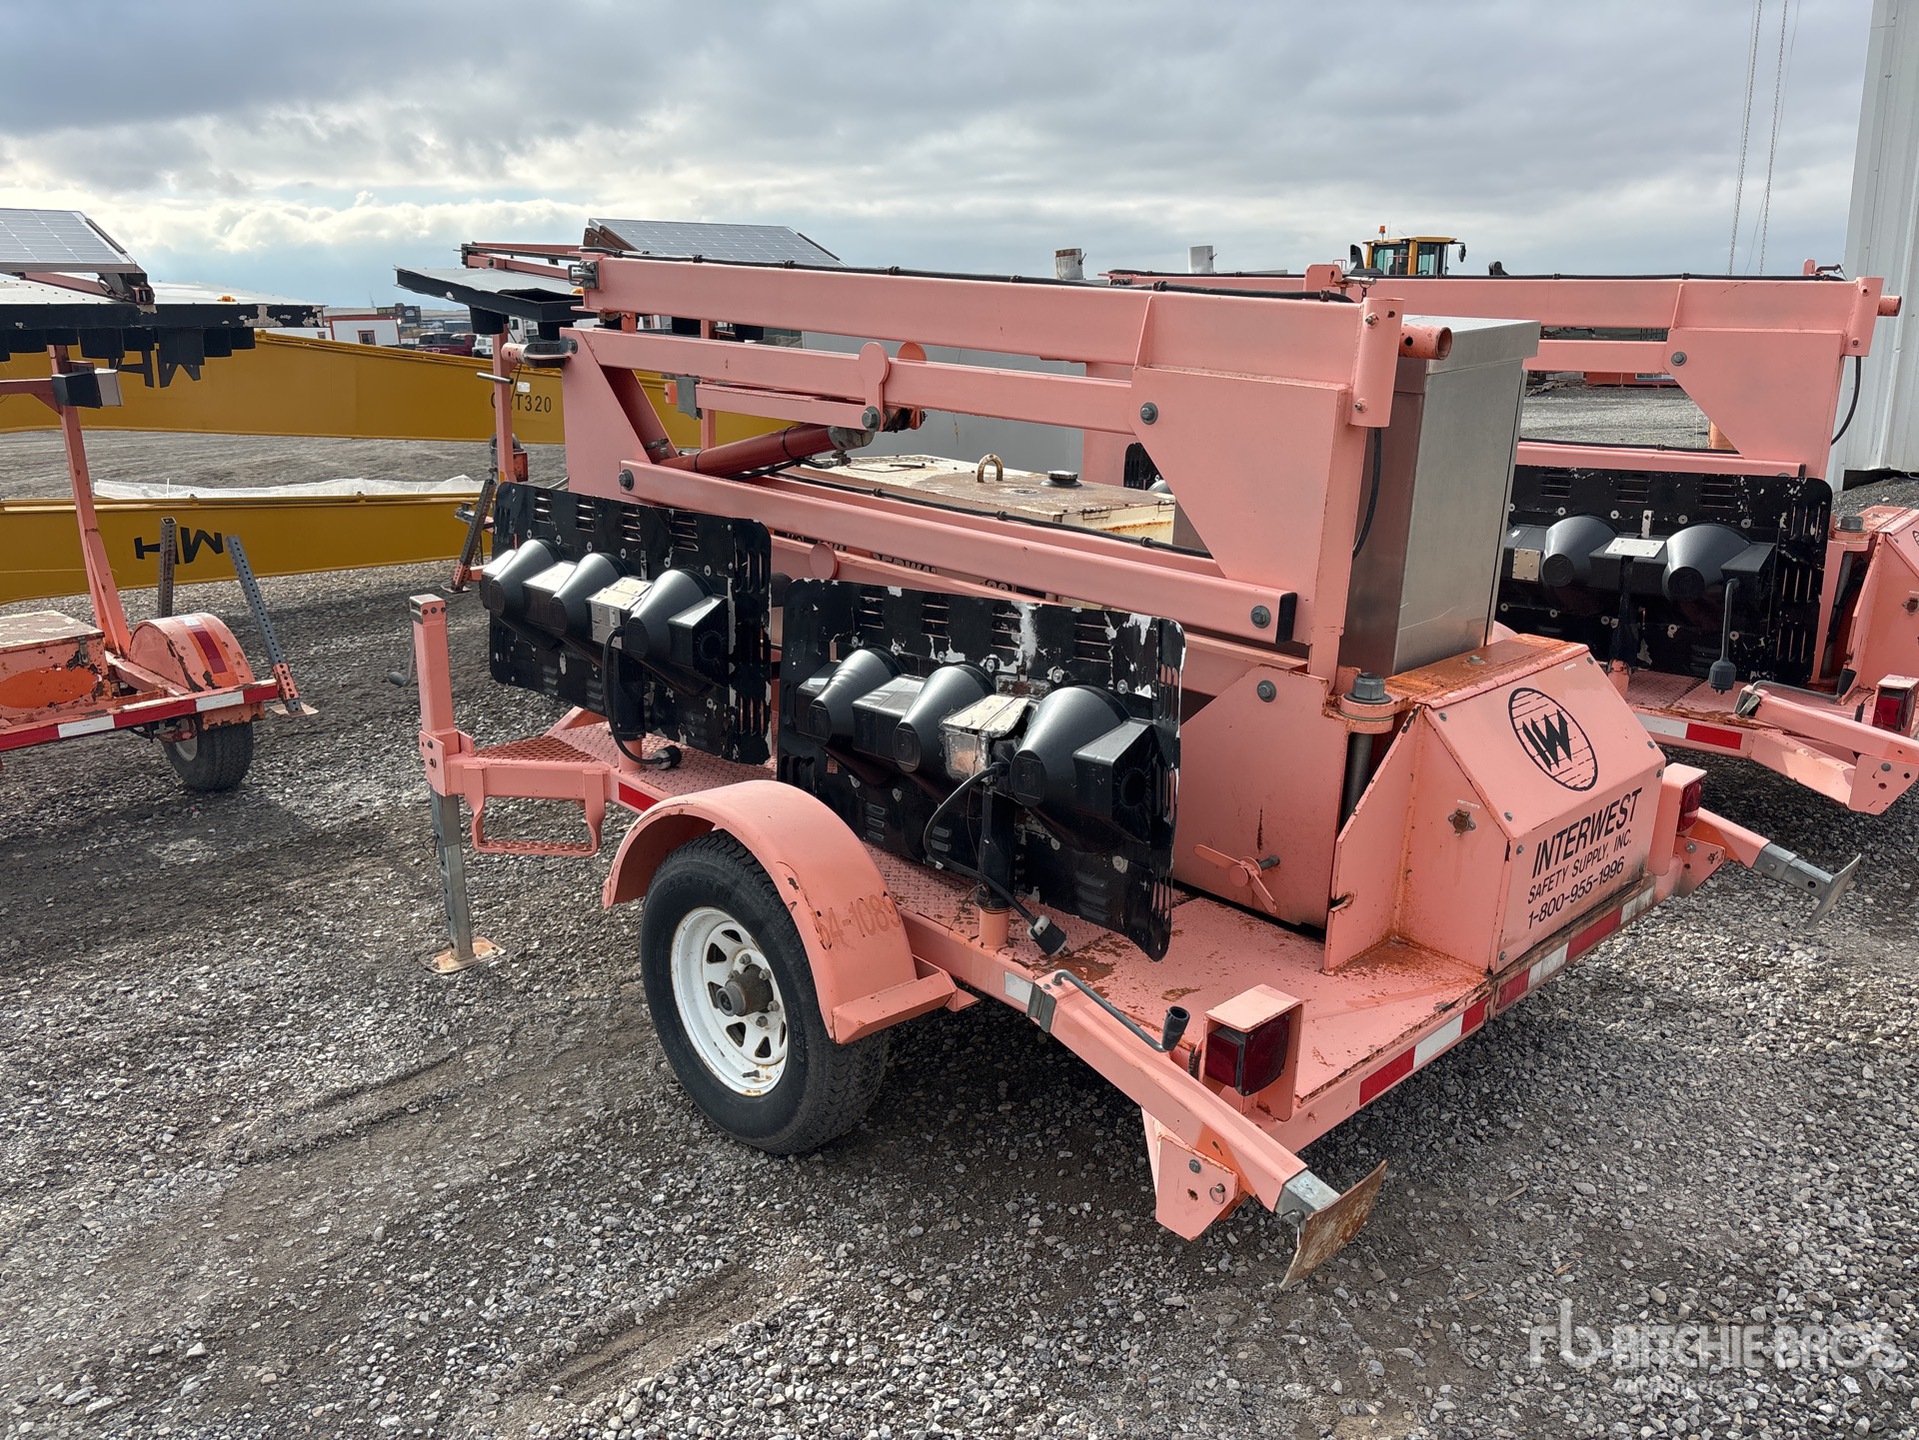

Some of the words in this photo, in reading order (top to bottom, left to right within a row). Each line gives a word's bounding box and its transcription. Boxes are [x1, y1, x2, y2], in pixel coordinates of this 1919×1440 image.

[1527, 864, 1570, 905] SAFETY
[1571, 842, 1609, 878] SUPPLY,
[1613, 829, 1632, 853] INC.
[1531, 786, 1643, 880] INTERWEST
[1527, 855, 1625, 930] 1-800-955-1996
